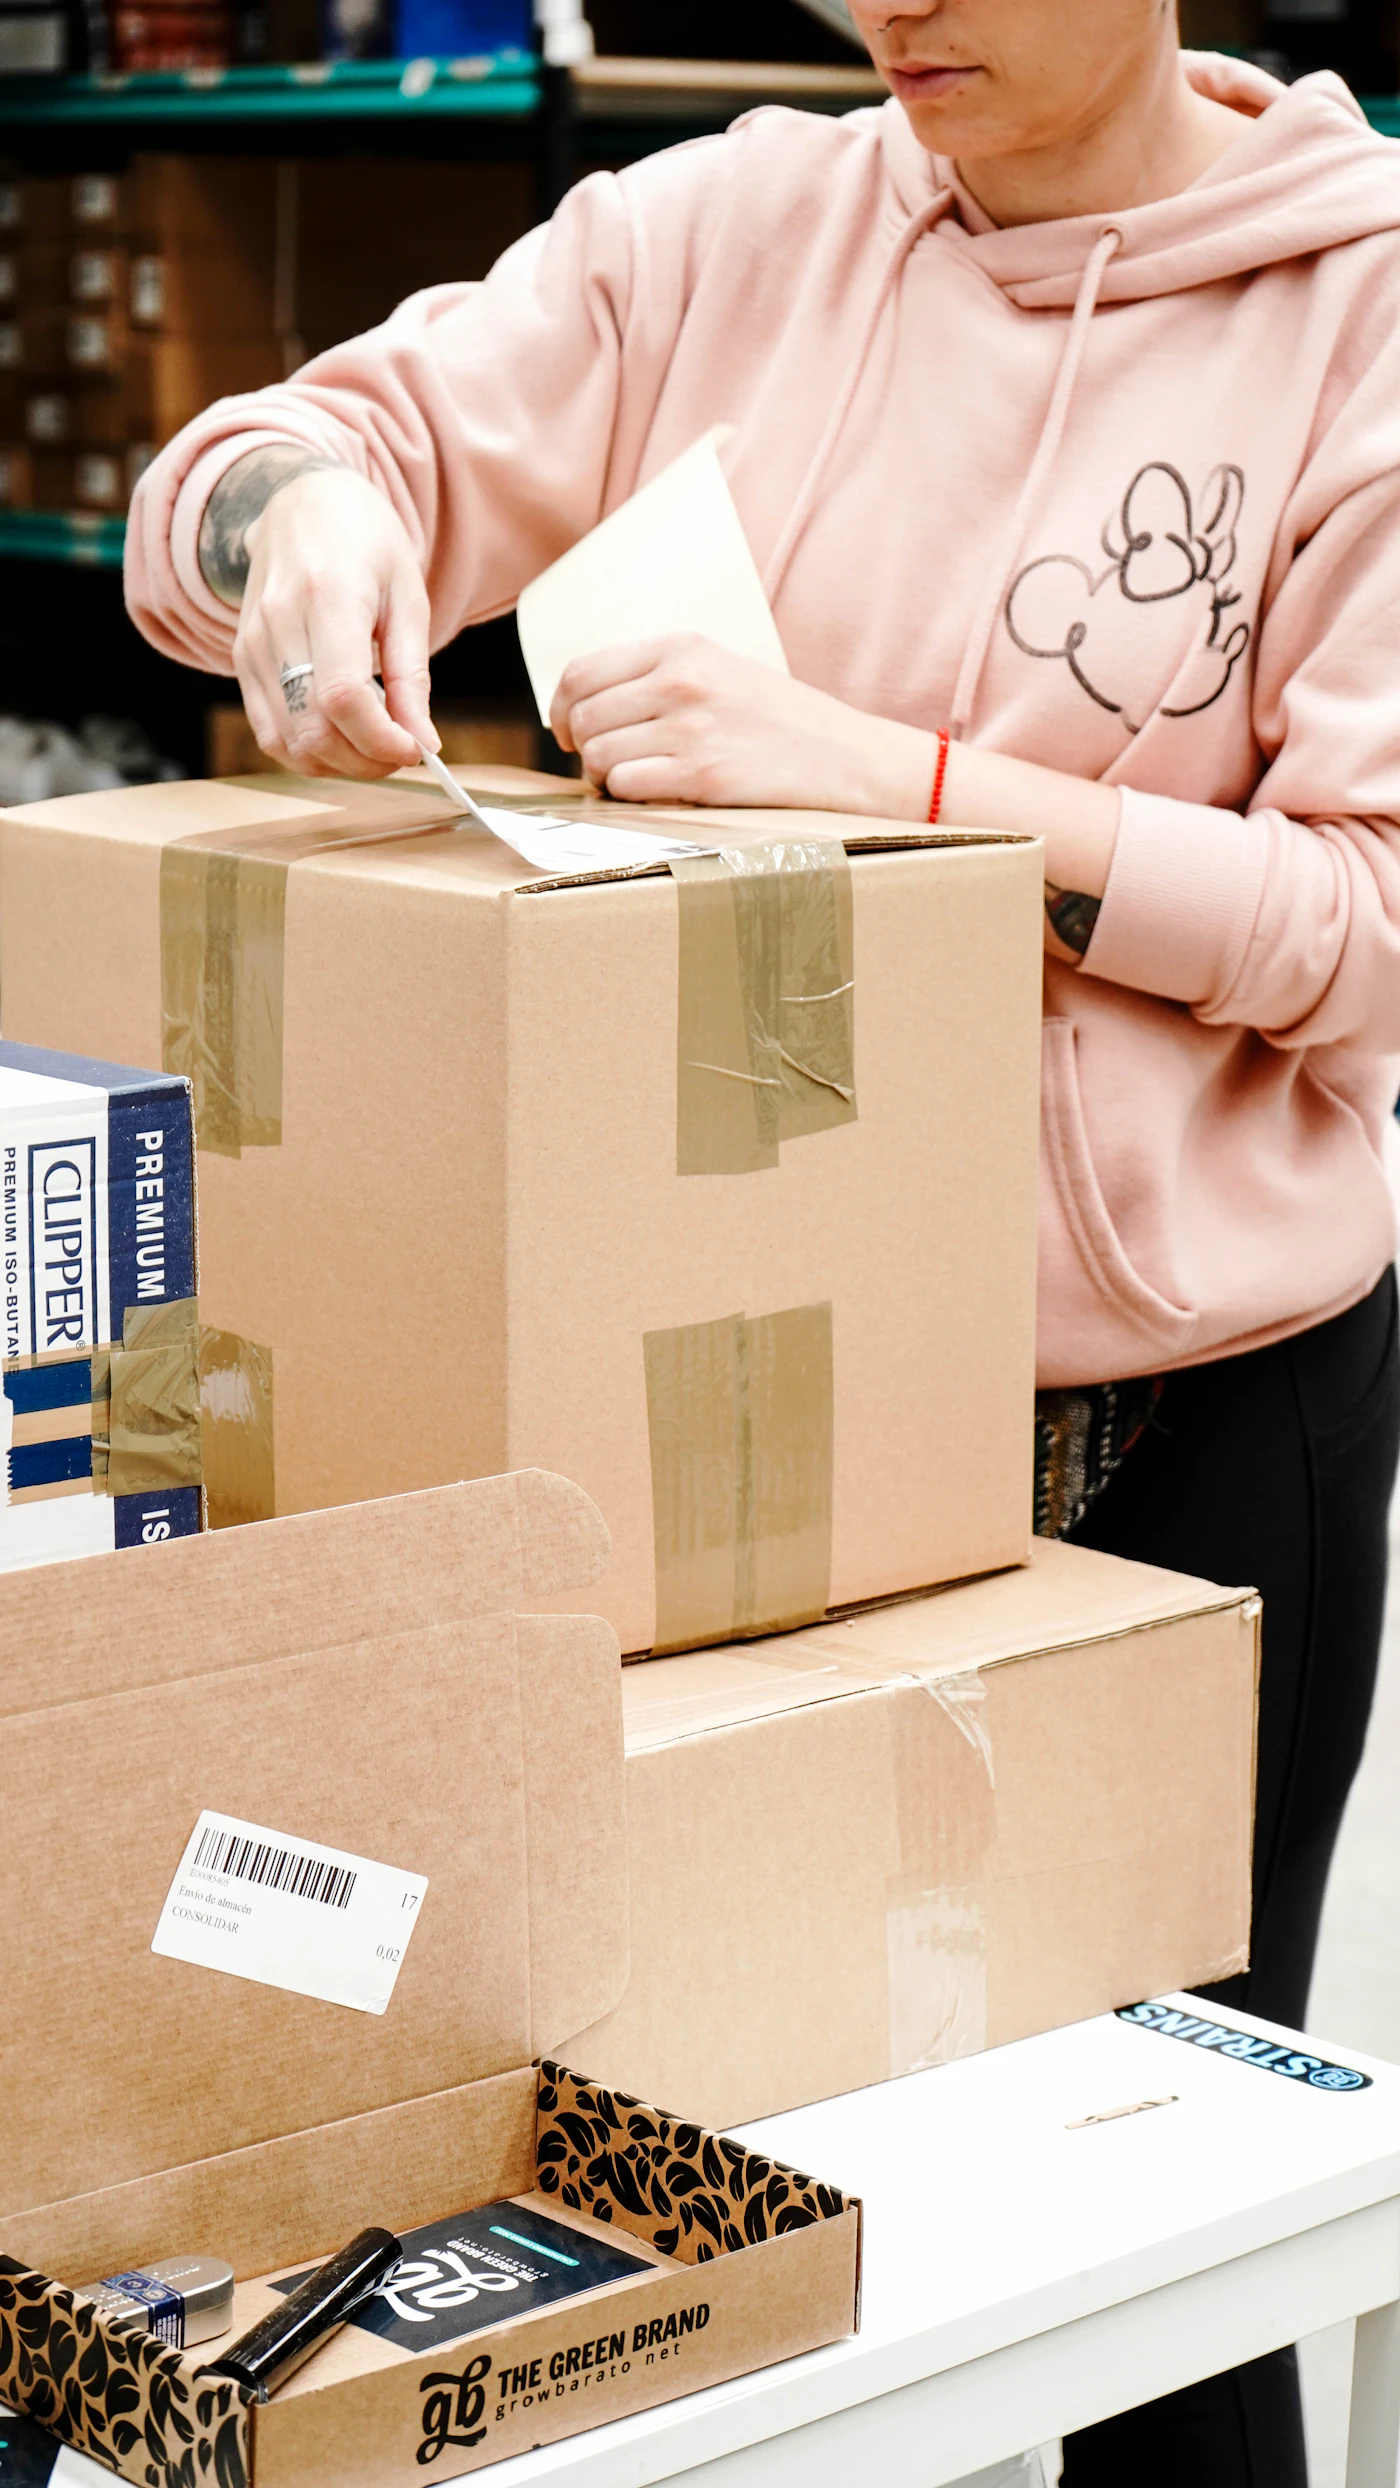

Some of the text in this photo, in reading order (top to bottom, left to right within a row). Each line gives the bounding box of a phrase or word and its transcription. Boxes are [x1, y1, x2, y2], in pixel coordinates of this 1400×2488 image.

[4, 1147, 16, 1243] PREMIUM
[136, 1130, 165, 1298] PREMIUM
[172, 1906, 239, 1934] CONSOLIDAR
[178, 1885, 252, 1915] Envío de almacén
[401, 1893, 418, 1910] 17
[376, 1945, 400, 1963] 0,02
[1119, 2003, 1322, 2076] STRAINS
[447, 2240, 539, 2282] THE GREEN BRAND
[495, 2343, 680, 2421] growbarato net
[498, 2303, 710, 2398] THE GREEN BRAND
[416, 2355, 492, 2465] gb
